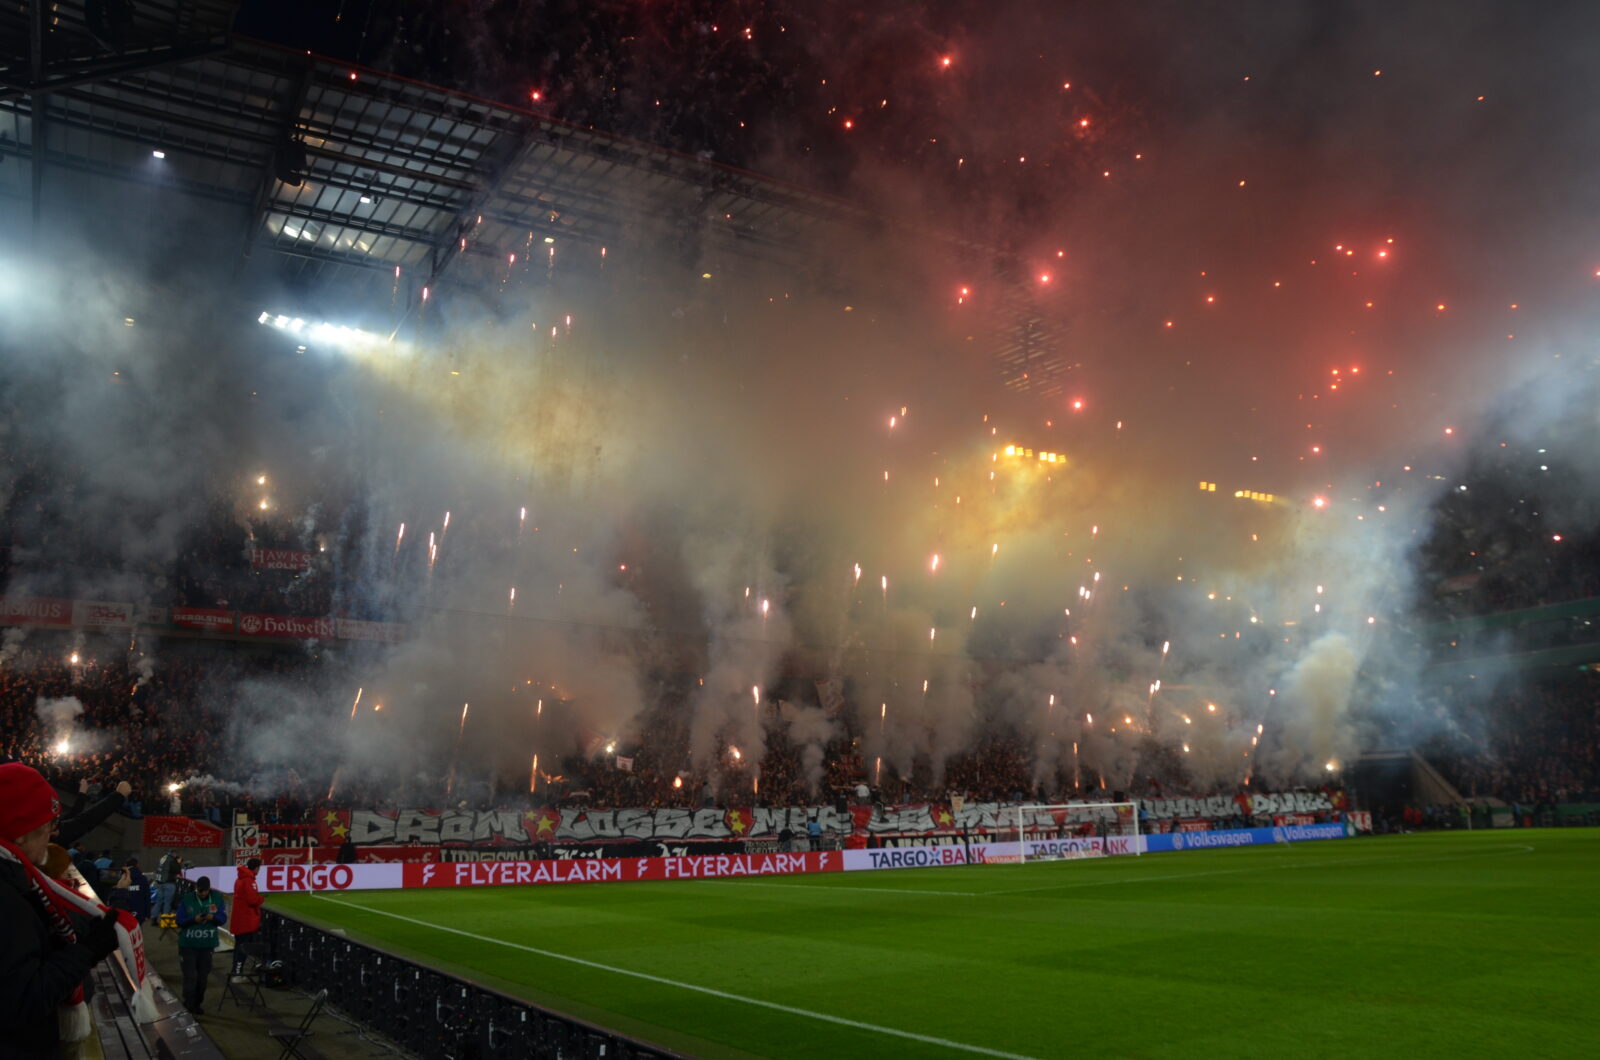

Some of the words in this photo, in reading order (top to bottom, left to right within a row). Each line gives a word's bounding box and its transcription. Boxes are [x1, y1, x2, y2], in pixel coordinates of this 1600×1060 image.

[1186, 830, 1253, 847] Volkswagen
[1284, 826, 1344, 840] Volkswagen
[266, 864, 353, 891] ERGO
[455, 859, 622, 885] FLYERALARM
[664, 853, 807, 879] FLYERALARM
[186, 928, 215, 939] HOST
